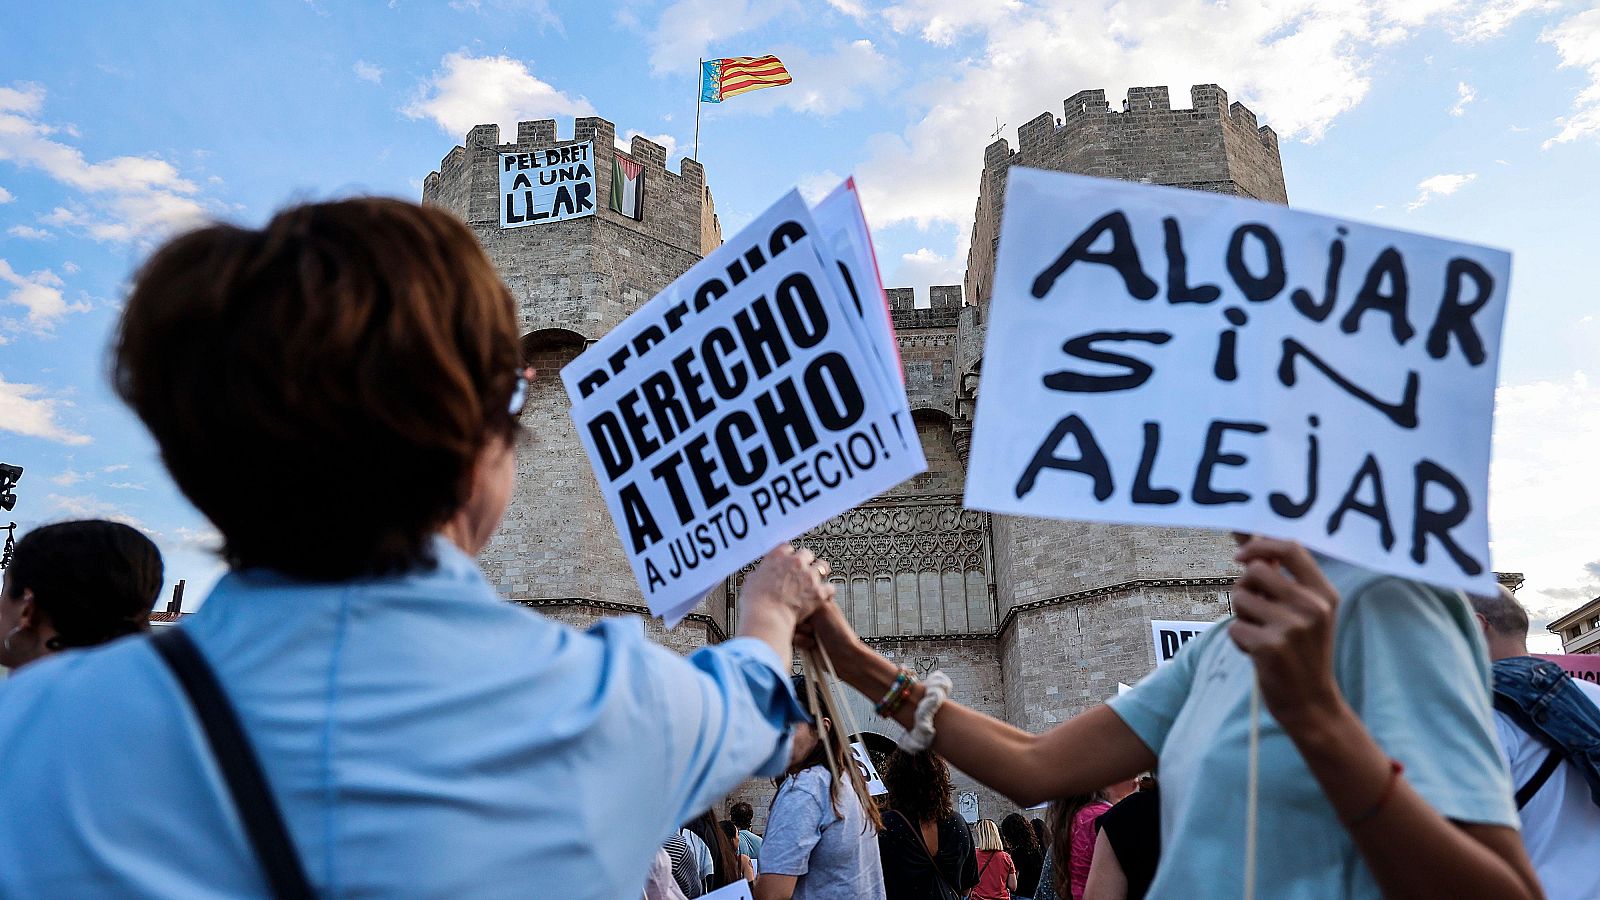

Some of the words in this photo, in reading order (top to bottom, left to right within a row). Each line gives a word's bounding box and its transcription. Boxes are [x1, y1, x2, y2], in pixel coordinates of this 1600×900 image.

[505, 153, 541, 172] PEL
[545, 145, 588, 166] DRET
[507, 182, 594, 224] LLAR
[513, 173, 532, 190] A
[540, 163, 592, 185] UNA
[587, 271, 829, 483] DERECHO
[618, 481, 665, 556] A
[650, 350, 866, 527] TECHO
[644, 556, 667, 594] A
[667, 503, 749, 580] JUSTO
[750, 422, 891, 528] PRECIO!
